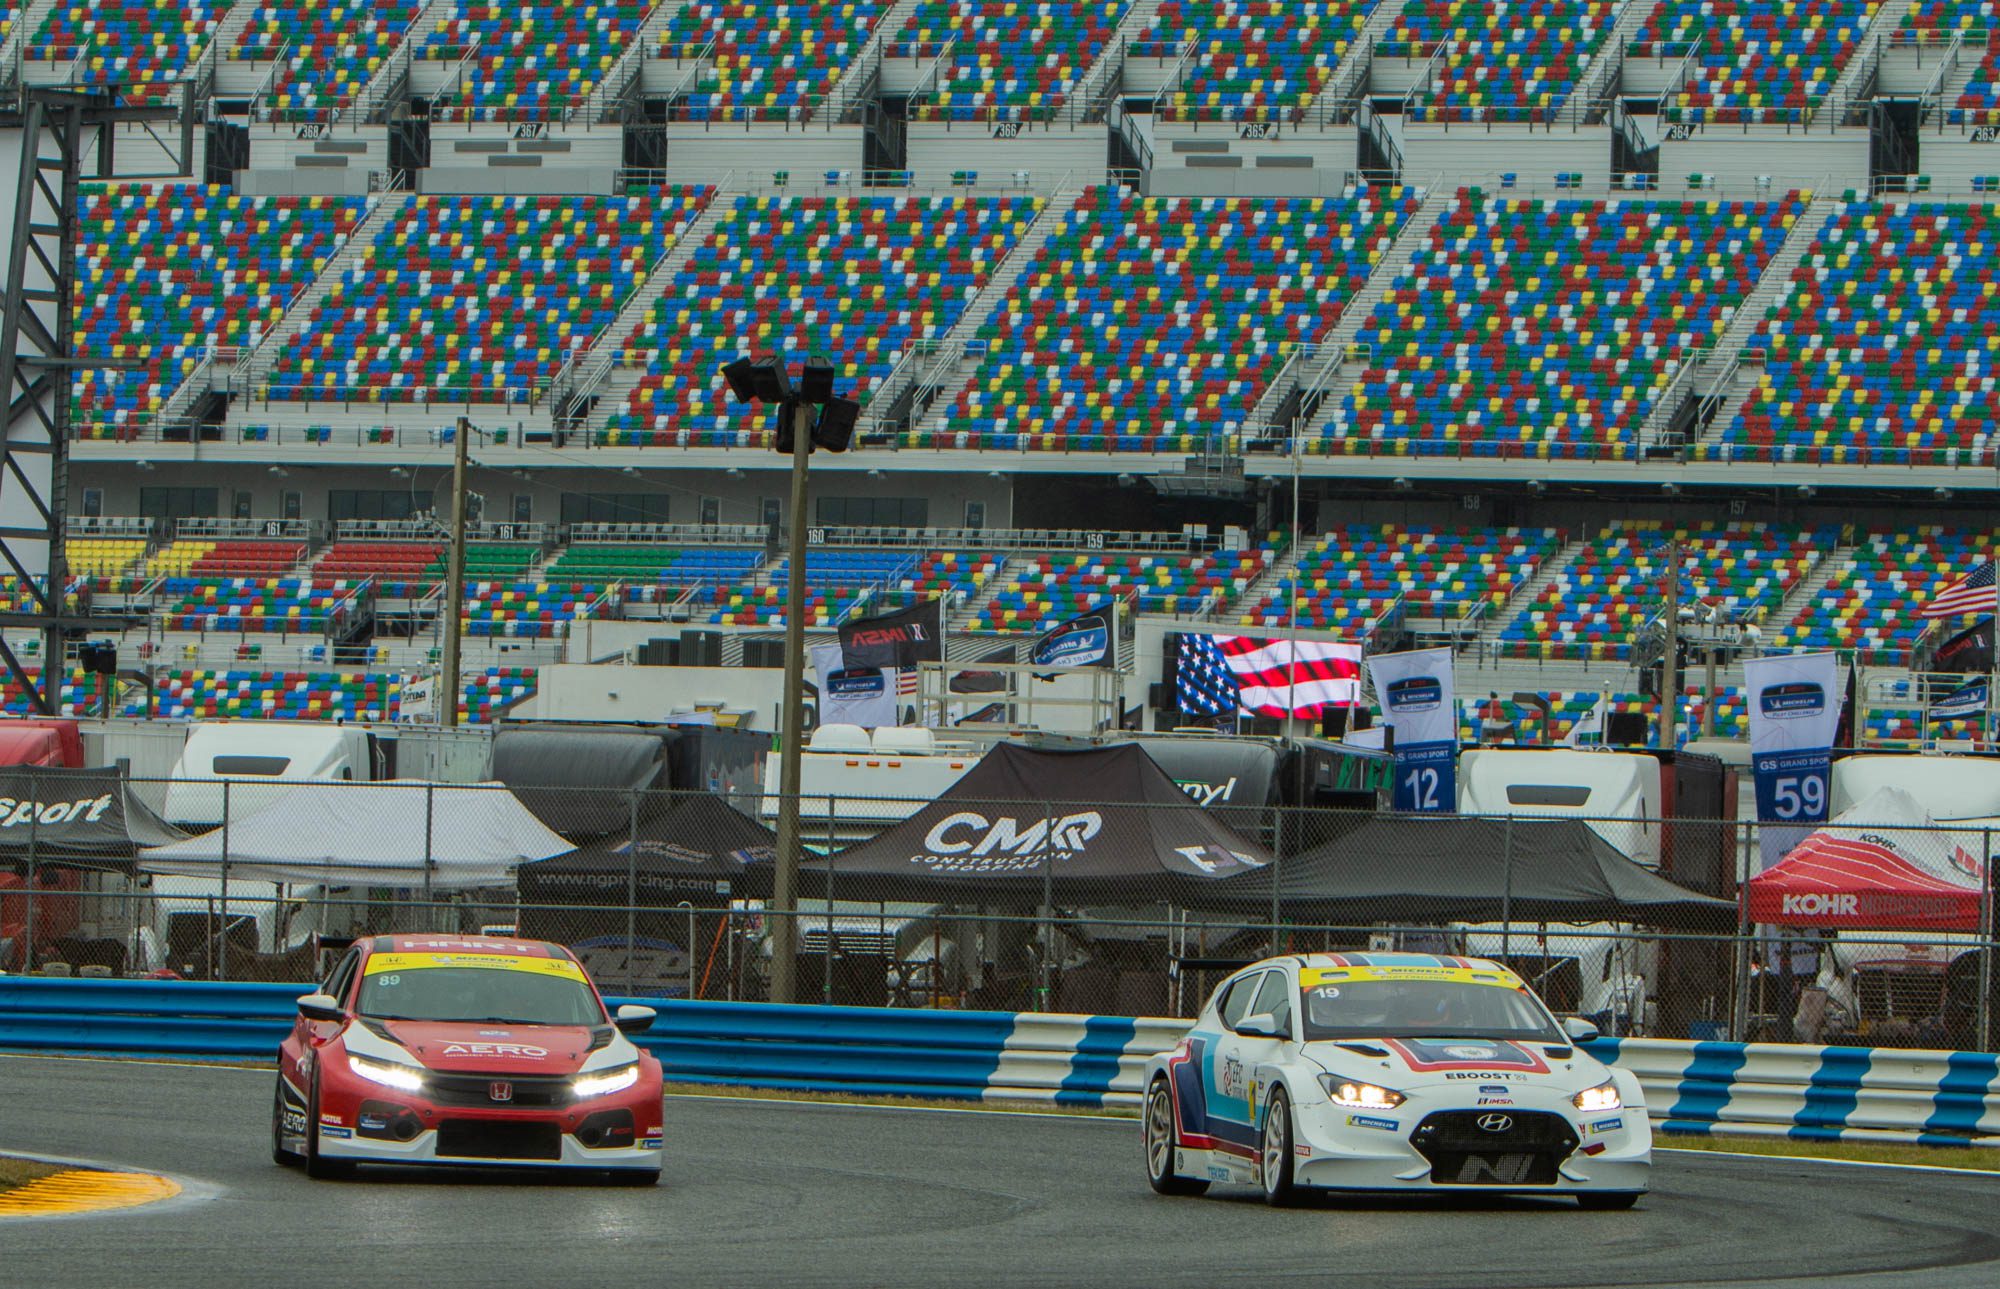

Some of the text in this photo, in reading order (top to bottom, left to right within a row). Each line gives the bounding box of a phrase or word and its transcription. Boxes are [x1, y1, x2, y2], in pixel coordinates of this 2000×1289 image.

[302, 125, 319, 139] 368
[520, 124, 537, 138] 367
[999, 123, 1017, 138] 366
[1246, 124, 1265, 139] 365
[1671, 125, 1689, 140] 364
[1976, 126, 1995, 142] 363
[1463, 494, 1480, 510] 158
[1730, 499, 1747, 515] 157
[267, 521, 281, 537] 161
[500, 525, 513, 540] 161
[808, 528, 825, 544] 160
[1087, 533, 1104, 549] 159
[1782, 698, 1816, 706] MICHELIN
[1428, 750, 1449, 759] SPORT
[1759, 760, 1777, 771] GS
[1780, 759, 1807, 768] GRAND
[1404, 768, 1439, 810] 12
[1775, 776, 1825, 818] 59
[1858, 833, 1897, 852] KOHR
[537, 874, 715, 892] www.ngprcing.com
[1782, 893, 1957, 918] KOHR MOTORSPORTS
[1169, 959, 1179, 978] N
[1391, 968, 1455, 976] MICHELIN
[378, 974, 401, 986] 89
[1313, 987, 1340, 999] 19
[442, 1045, 549, 1057] AERO
[1445, 1072, 1512, 1081] EBOOST
[1360, 1119, 1396, 1129] MICHELIN
